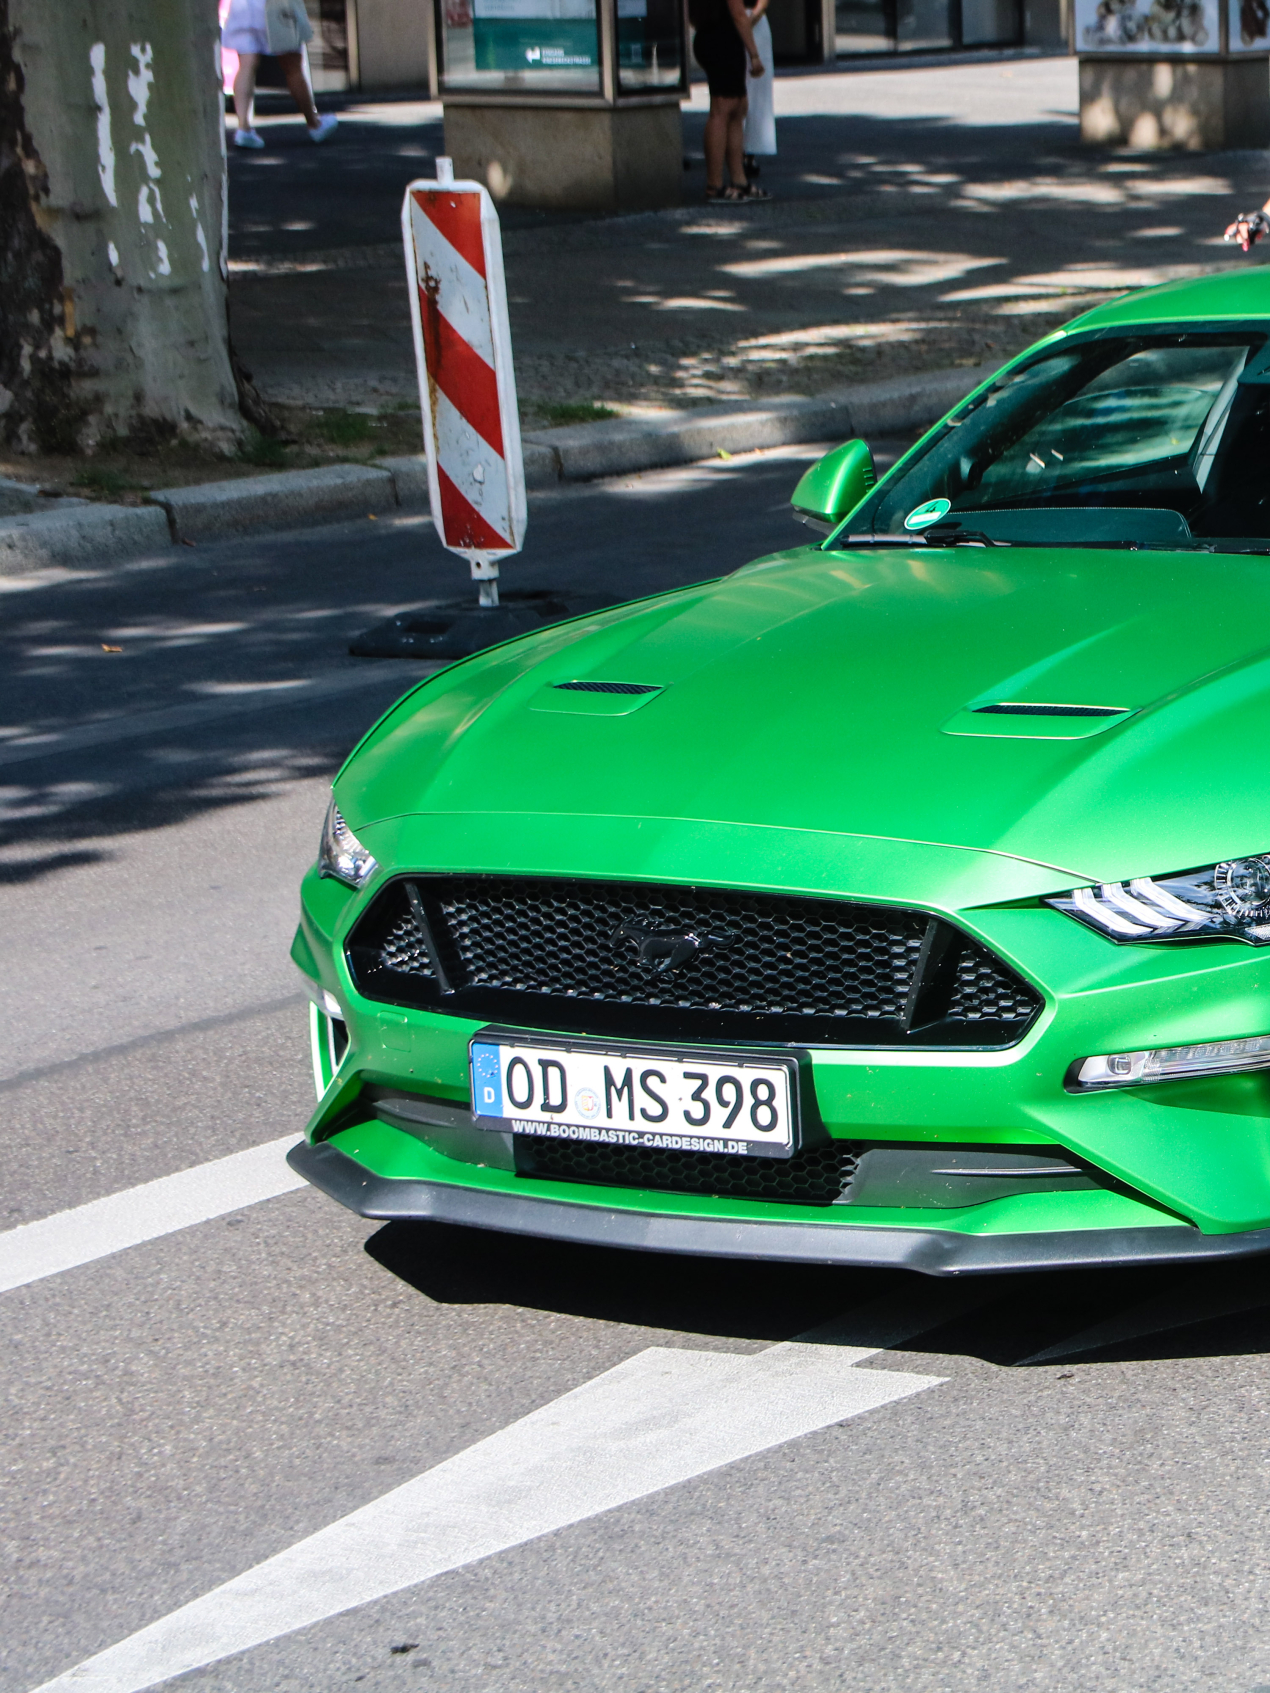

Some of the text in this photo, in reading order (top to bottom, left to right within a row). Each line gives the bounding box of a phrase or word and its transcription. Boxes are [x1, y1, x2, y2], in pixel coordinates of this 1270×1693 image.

[483, 1086, 496, 1104] D
[506, 1056, 568, 1114] OD
[603, 1065, 669, 1123] MS
[683, 1071, 779, 1132] 398
[511, 1119, 749, 1155] WWW.BOOMBASTIC-CARDESIGN.DE
